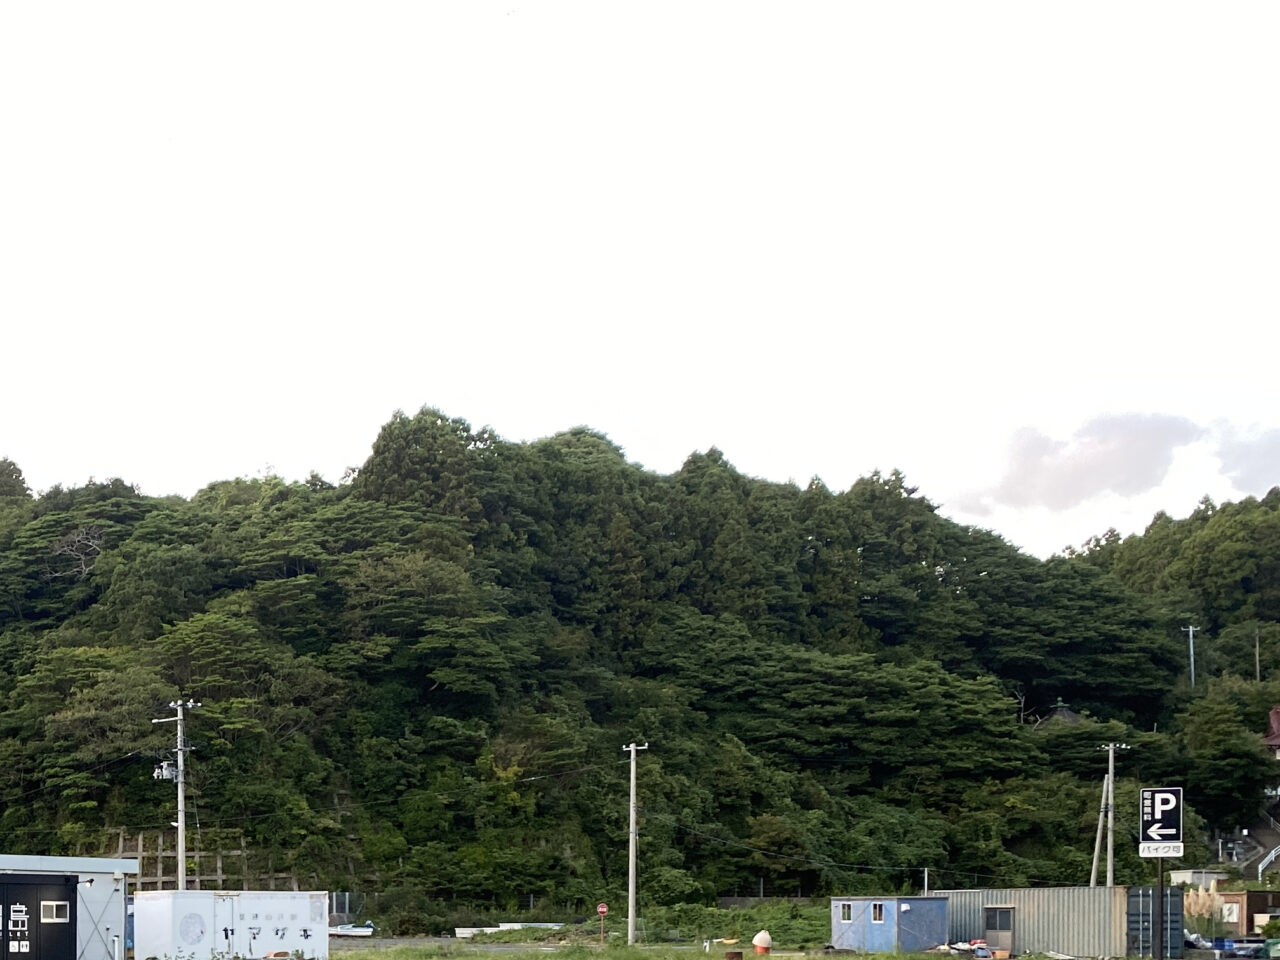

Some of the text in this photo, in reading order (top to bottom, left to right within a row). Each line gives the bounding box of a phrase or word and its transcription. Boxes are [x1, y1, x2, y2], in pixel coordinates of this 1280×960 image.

[1154, 793, 1177, 820] P
[1142, 845, 1181, 854] バイク可
